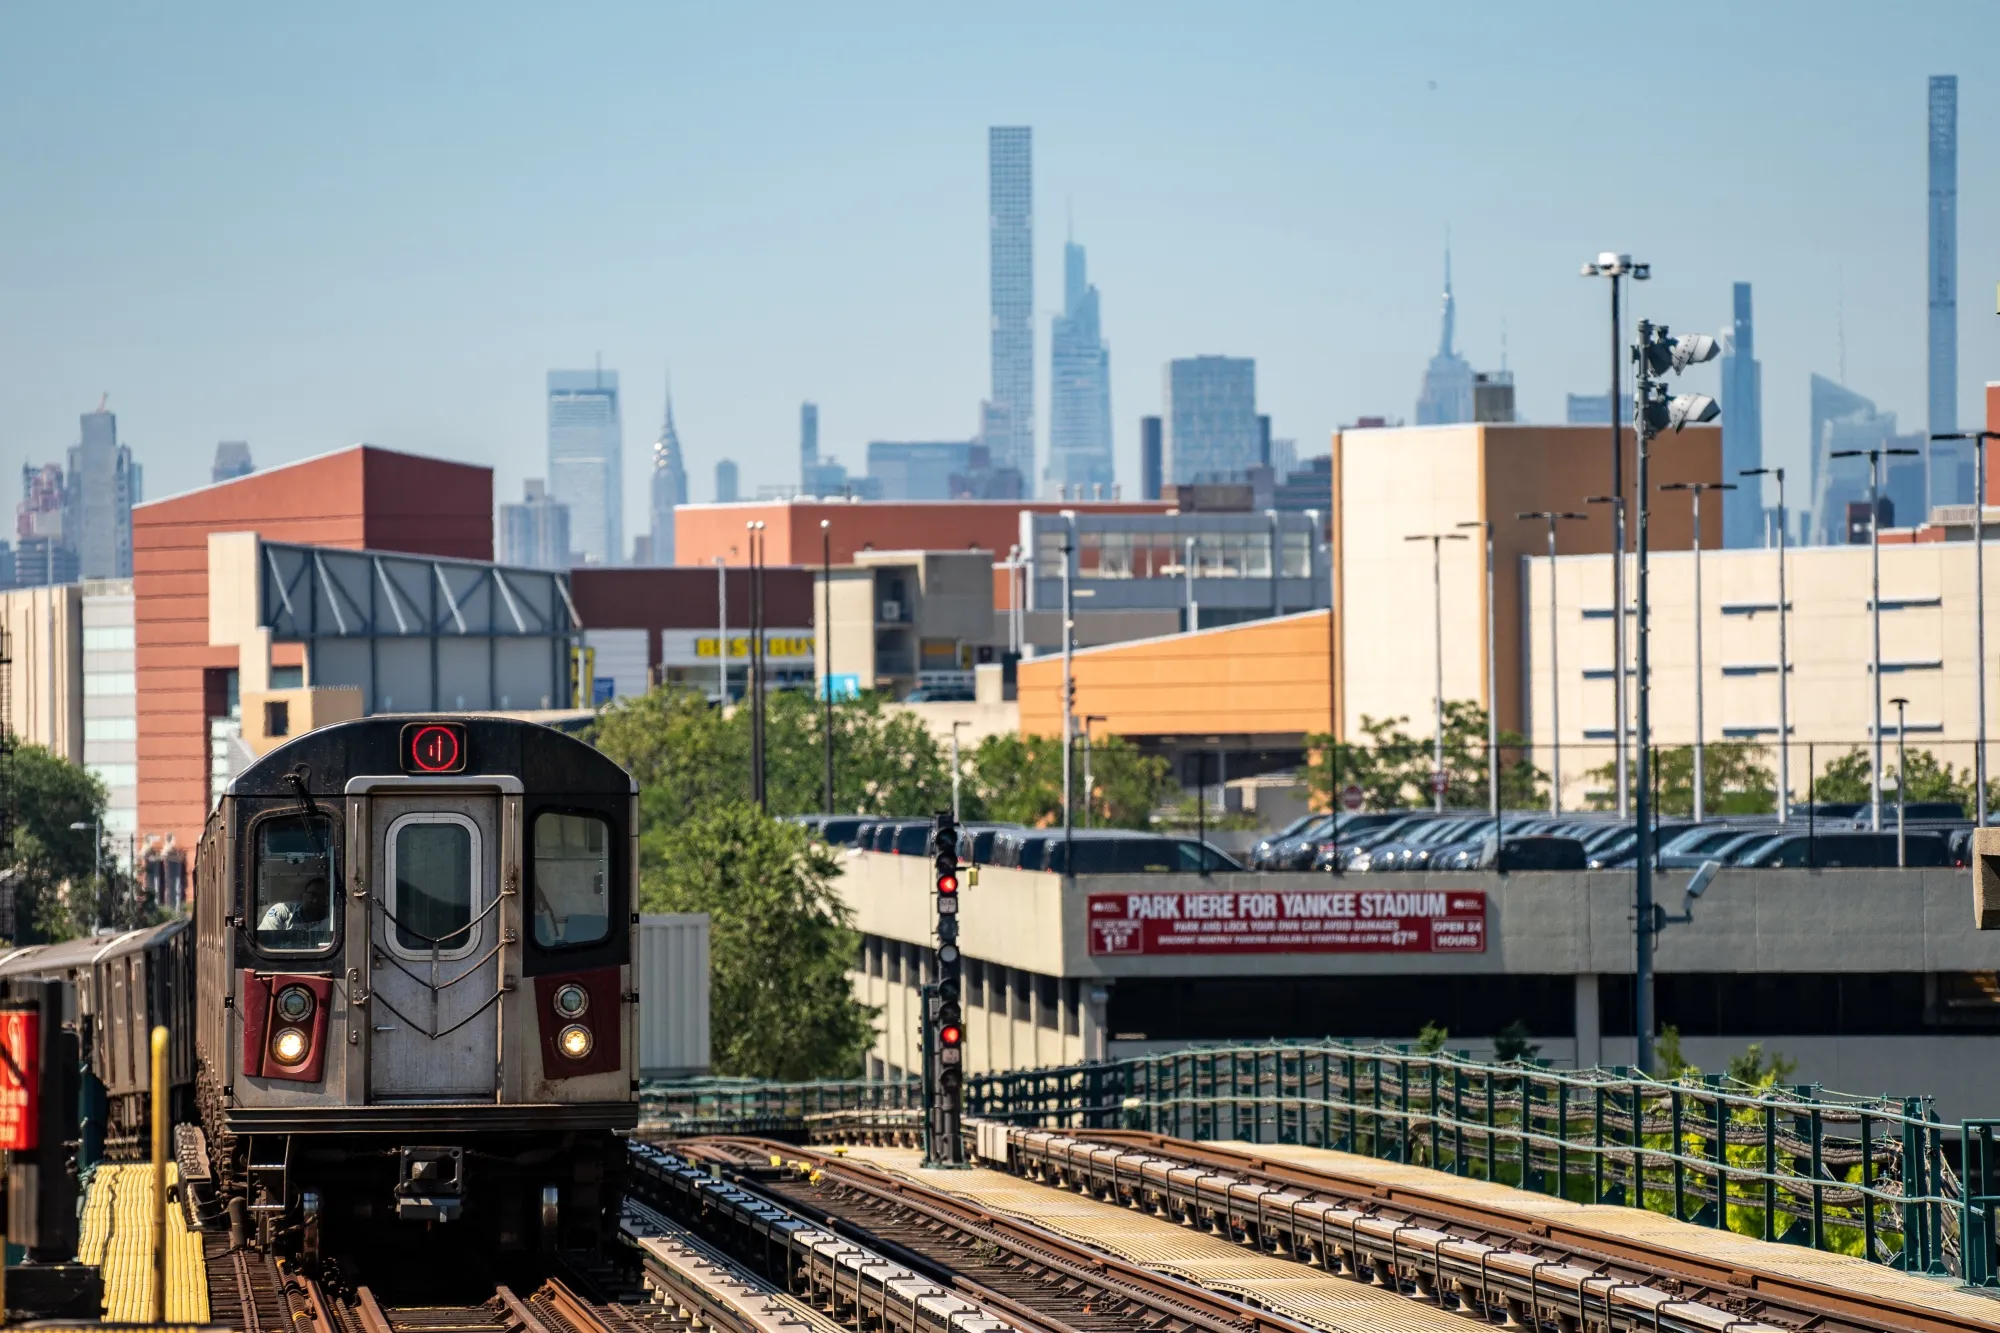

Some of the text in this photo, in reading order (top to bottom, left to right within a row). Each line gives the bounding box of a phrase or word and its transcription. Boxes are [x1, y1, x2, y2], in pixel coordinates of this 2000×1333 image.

[1128, 894, 1181, 919] PARK
[1184, 894, 1236, 919] HERE
[1238, 893, 1278, 918] FOR
[1281, 893, 1356, 918] YANKEE
[1359, 893, 1447, 918] STADIUM
[1173, 921, 1200, 933] PARK
[1201, 921, 1222, 933] AND
[1223, 920, 1249, 933] LOCK
[1277, 920, 1300, 932] OWN
[1301, 920, 1322, 932] CAR
[1323, 919, 1352, 931] AVOID
[1432, 921, 1481, 933] OPEN 24
[1437, 934, 1477, 947] HOURS
